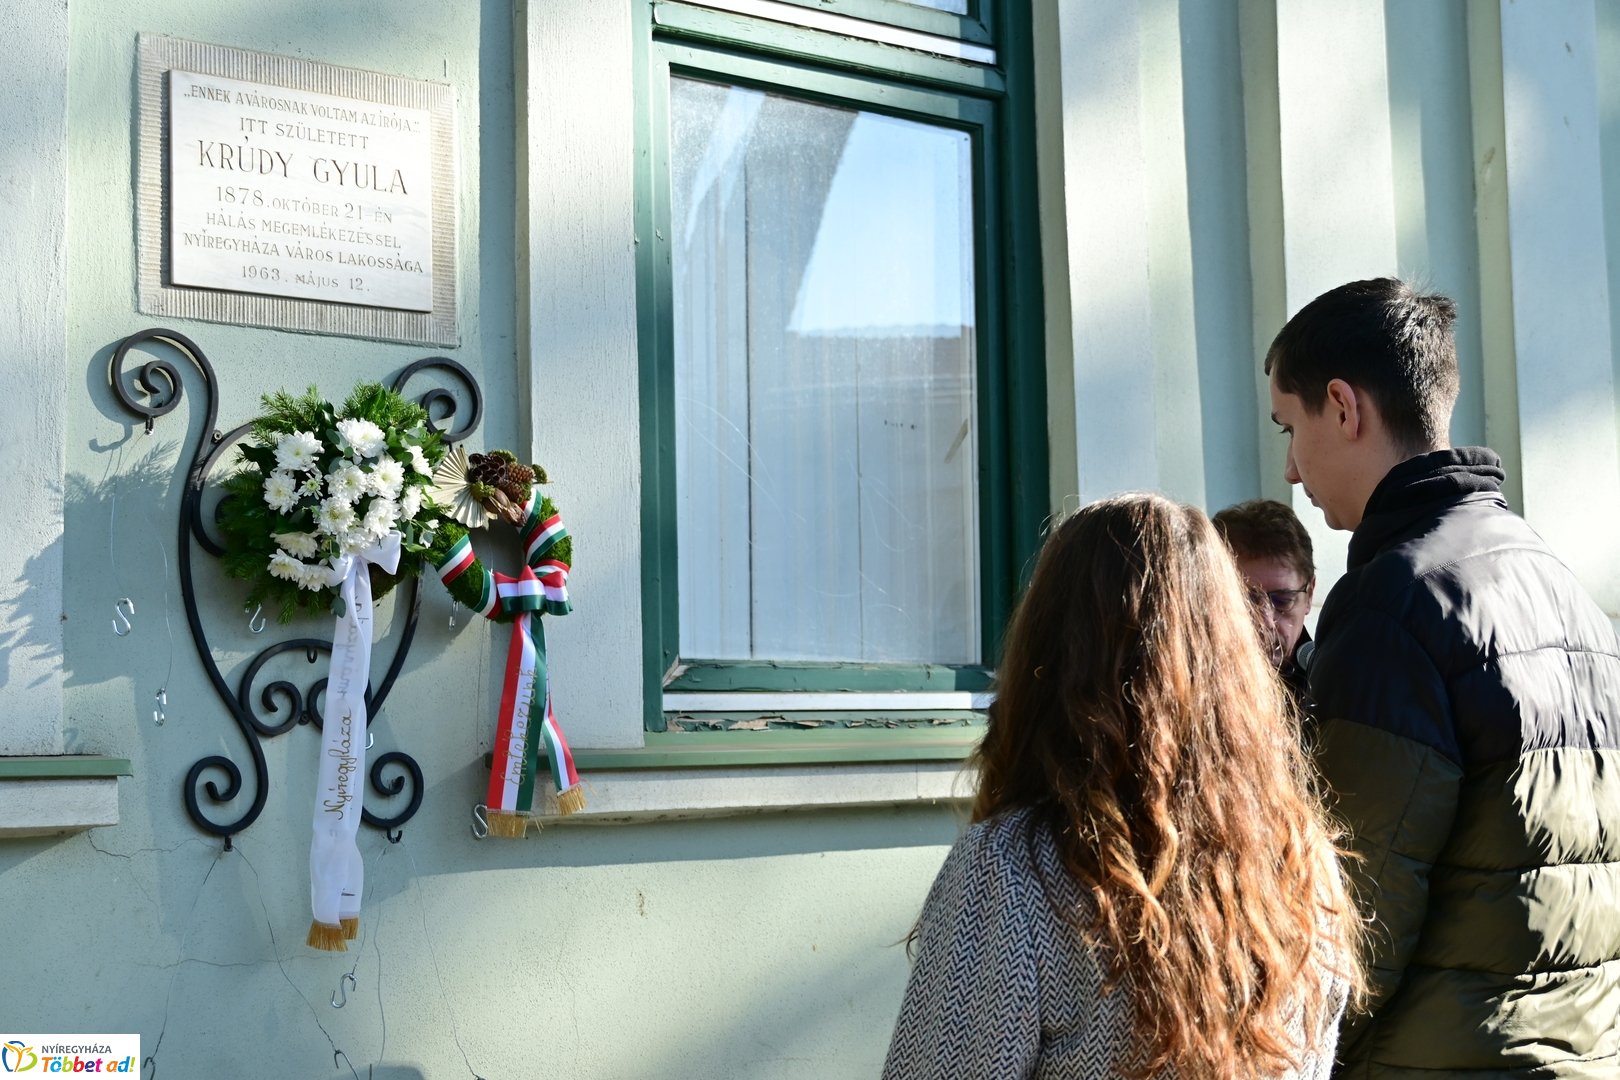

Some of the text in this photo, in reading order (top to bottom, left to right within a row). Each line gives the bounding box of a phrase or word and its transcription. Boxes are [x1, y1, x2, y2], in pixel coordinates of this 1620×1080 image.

[310, 103, 357, 123] VOLTAM
[240, 117, 369, 149] ITT SZÜLETETT
[197, 135, 408, 195] KRÚDY GYULA
[272, 196, 339, 217] OKTÓBER
[206, 207, 402, 249] HÁLÁS MEGEMLÉKEZÉSSEL
[183, 228, 424, 273] NYÍREGYHÁZA VÁROS LAKOSSÁGA
[295, 270, 340, 288] MÁJUS
[349, 277, 370, 292] 12.
[323, 706, 358, 821] Nyíregyháza
